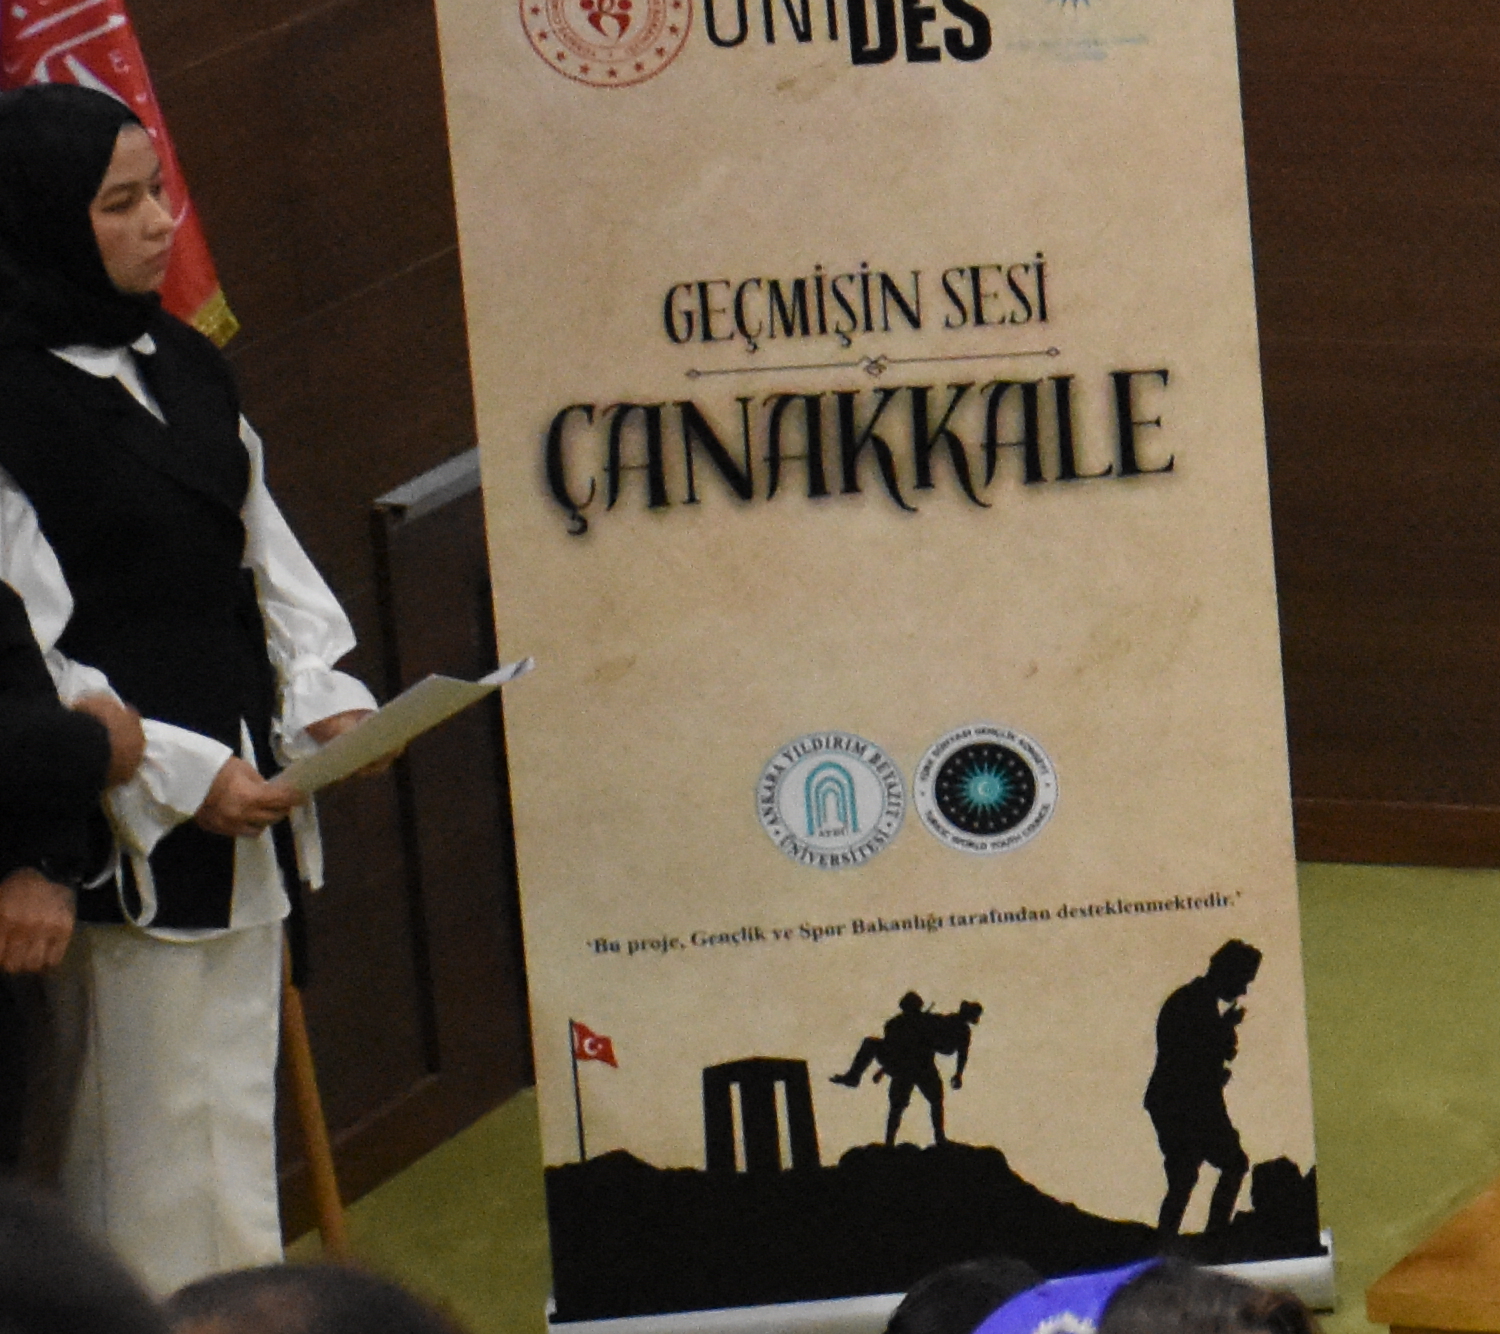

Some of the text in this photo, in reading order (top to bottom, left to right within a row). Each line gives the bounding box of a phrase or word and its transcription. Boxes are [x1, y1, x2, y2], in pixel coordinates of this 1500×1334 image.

[663, 251, 1052, 353] GEÇMİŞİN SESİ
[542, 368, 1176, 538] ÇANAKKALE
[782, 735, 868, 763] YILDIRIM
[627, 936, 687, 956] proje,
[689, 925, 767, 948] Gençlik
[771, 927, 795, 942] ve
[798, 921, 847, 943] Spor
[949, 905, 1051, 928] tarafından
